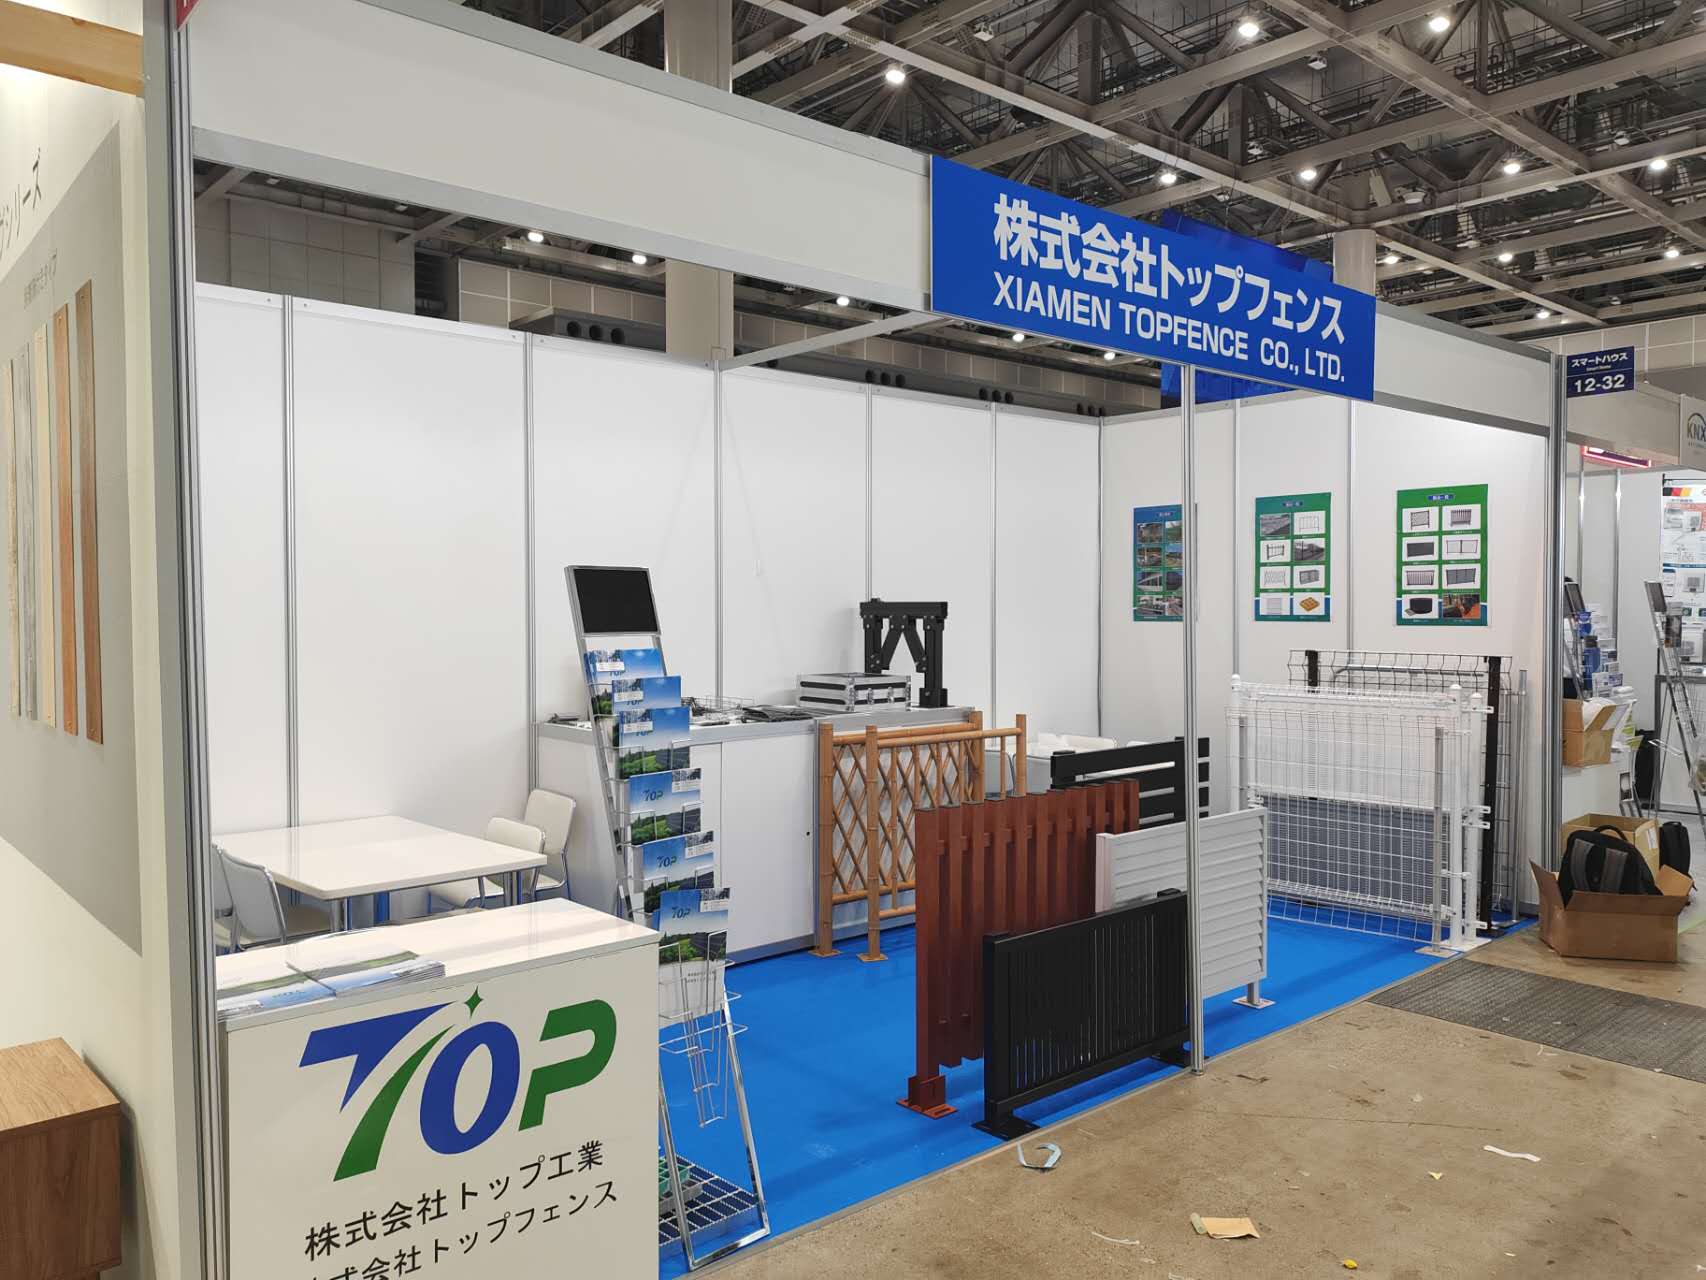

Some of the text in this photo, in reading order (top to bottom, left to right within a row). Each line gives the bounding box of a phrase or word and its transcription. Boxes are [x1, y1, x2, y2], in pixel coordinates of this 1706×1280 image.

[993, 192, 1346, 345] 株式会社トップフェンス
[993, 271, 1112, 331] XIAMEN
[1118, 302, 1249, 361] TOPFENCE
[1571, 352, 1629, 367] スマートハウス
[1574, 373, 1625, 393] 12-32
[298, 998, 618, 1182] TOP
[304, 1139, 604, 1262] 株式会社トップ工業
[312, 1179, 619, 1280] 会社トップフェンス
